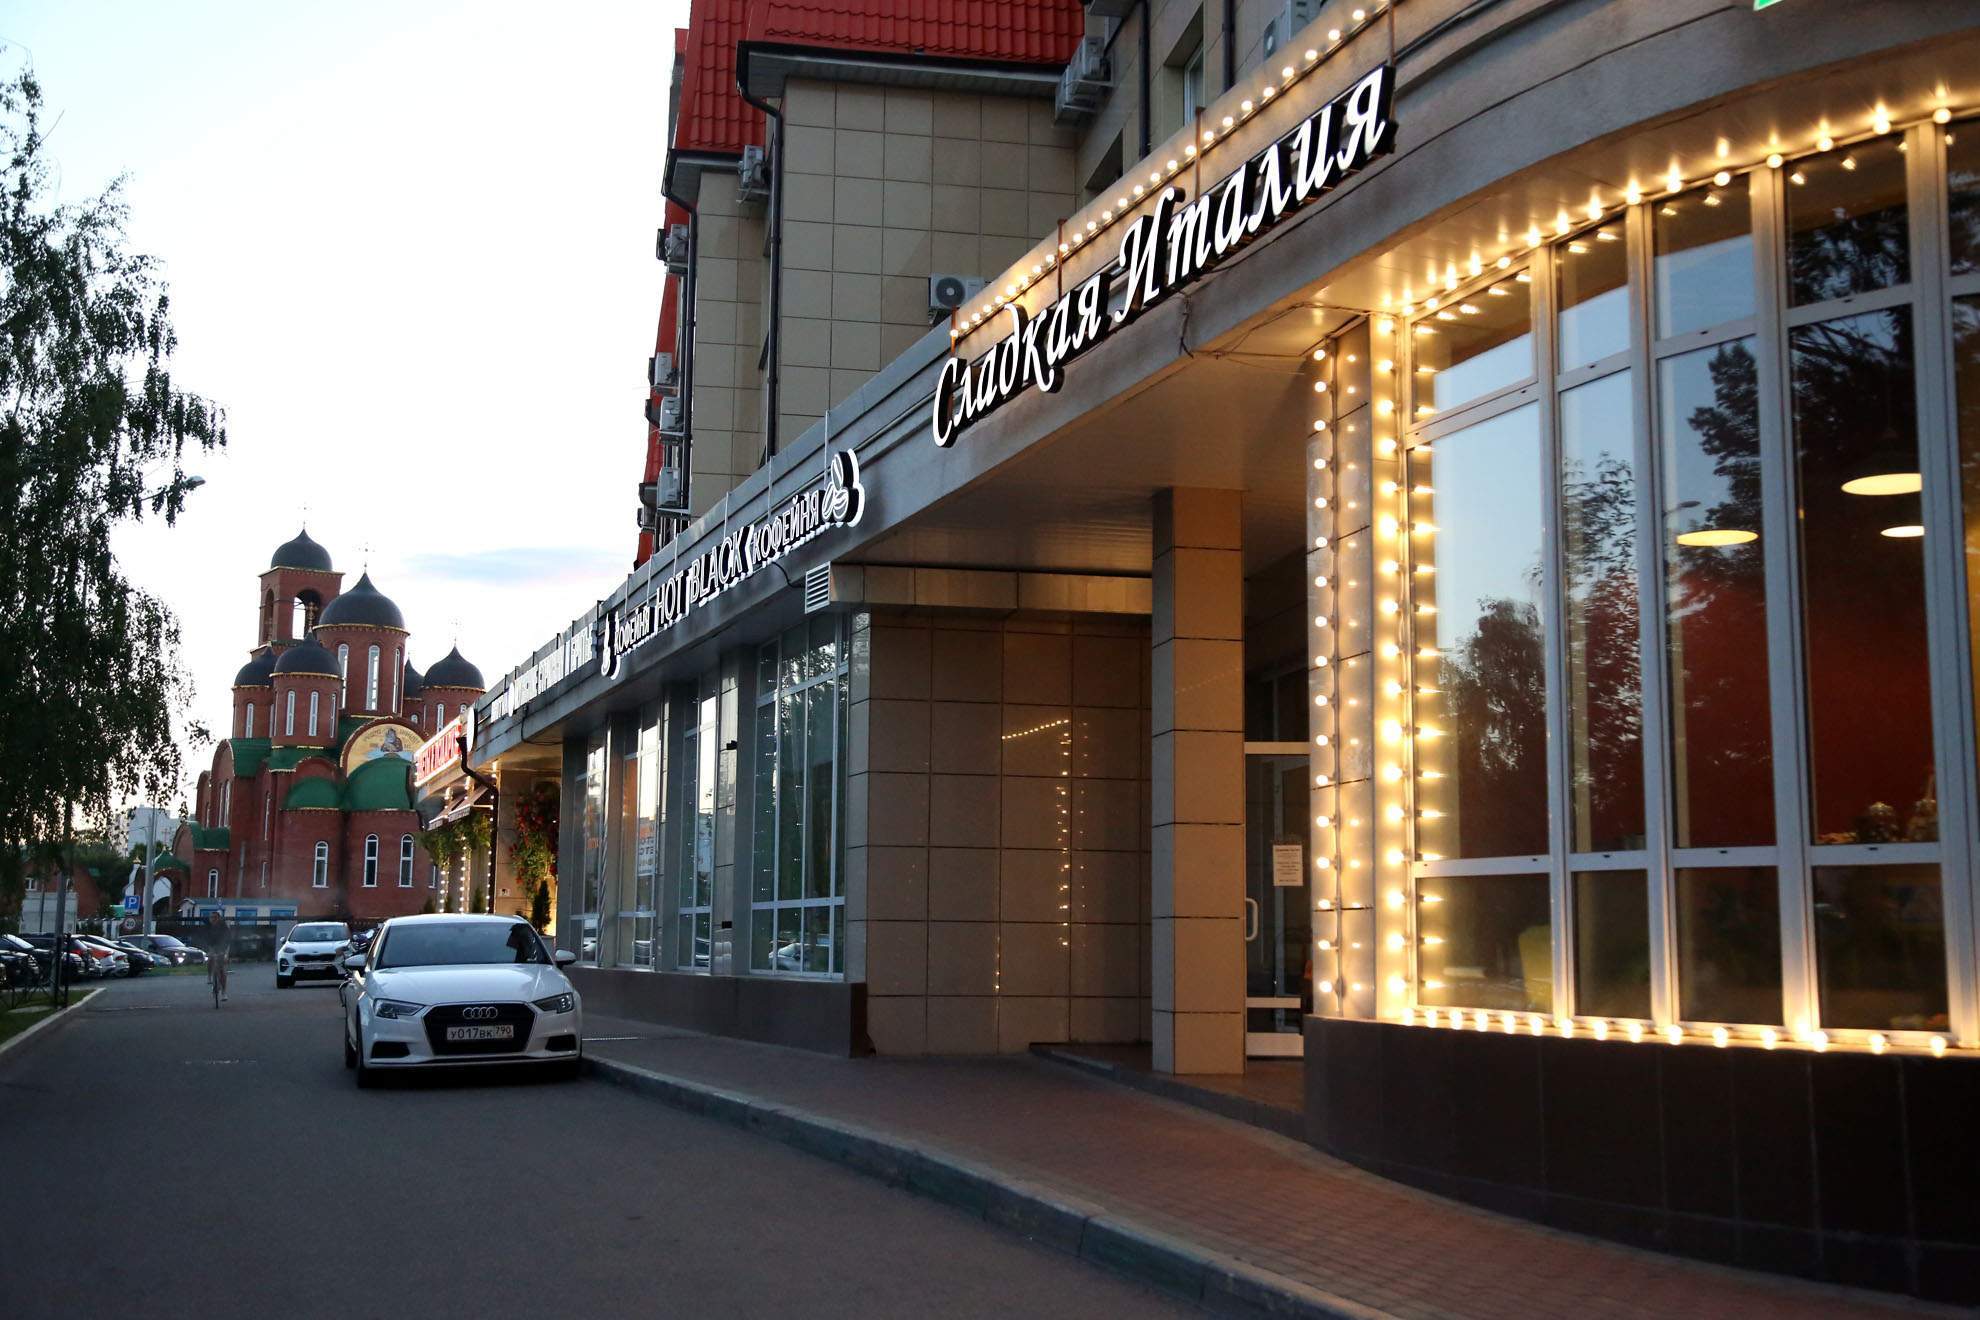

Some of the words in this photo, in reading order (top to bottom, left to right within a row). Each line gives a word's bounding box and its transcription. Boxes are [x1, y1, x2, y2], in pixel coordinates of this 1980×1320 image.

[933, 273, 1102, 447] Сладкая
[1115, 66, 1386, 323] Италия
[655, 569, 684, 624] HOT
[690, 527, 744, 604] BLACK
[752, 490, 819, 564] КОФЕЙНЯ
[128, 897, 137, 908] P
